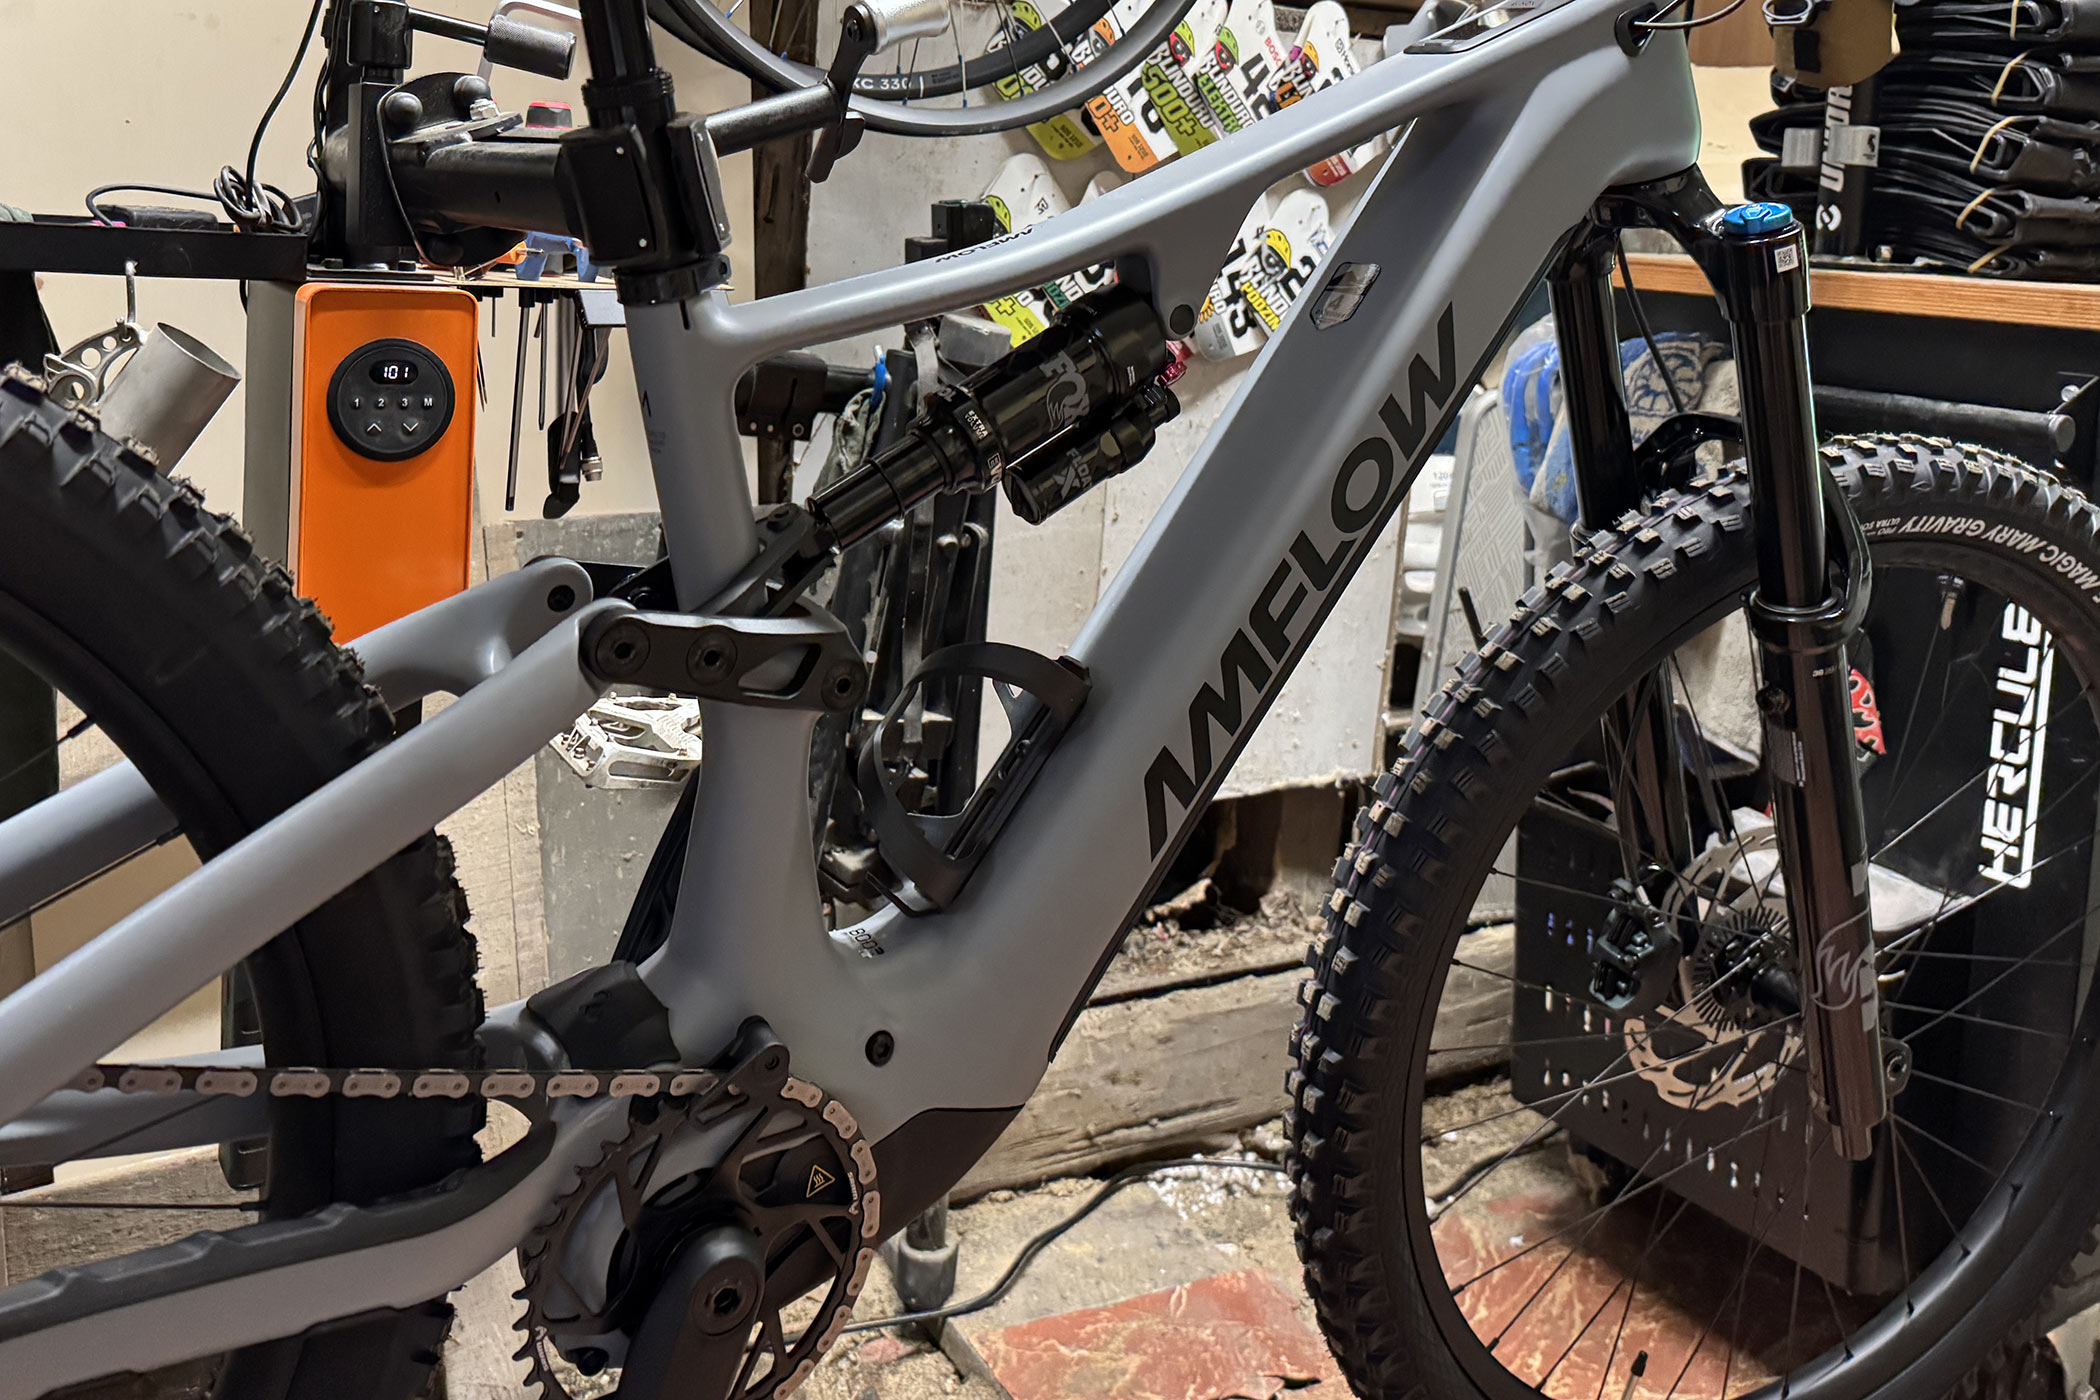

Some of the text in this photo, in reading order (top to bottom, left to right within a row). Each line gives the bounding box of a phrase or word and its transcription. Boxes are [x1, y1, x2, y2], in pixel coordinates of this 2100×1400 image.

[1264, 36, 1283, 67] BOSC
[881, 78, 912, 89] 330
[1142, 62, 1198, 136] 500+
[1146, 40, 1216, 129] BLINDURO
[1820, 85, 1853, 192] UOR
[1240, 253, 1291, 317] BLIND
[383, 366, 409, 380] 101
[1039, 350, 1091, 428] FOX
[378, 398, 385, 407] 2
[402, 398, 408, 407] 3
[423, 398, 433, 407] M
[967, 409, 989, 437] EXTRA
[987, 452, 1001, 484] EVO
[1860, 521, 1875, 531] SO
[1898, 515, 1987, 537] GRAVITY
[1981, 523, 2047, 553] MARY
[1144, 301, 1456, 863] AMFLOW
[2039, 546, 2100, 591] MAGIC
[1978, 601, 2043, 887] HERCULE
